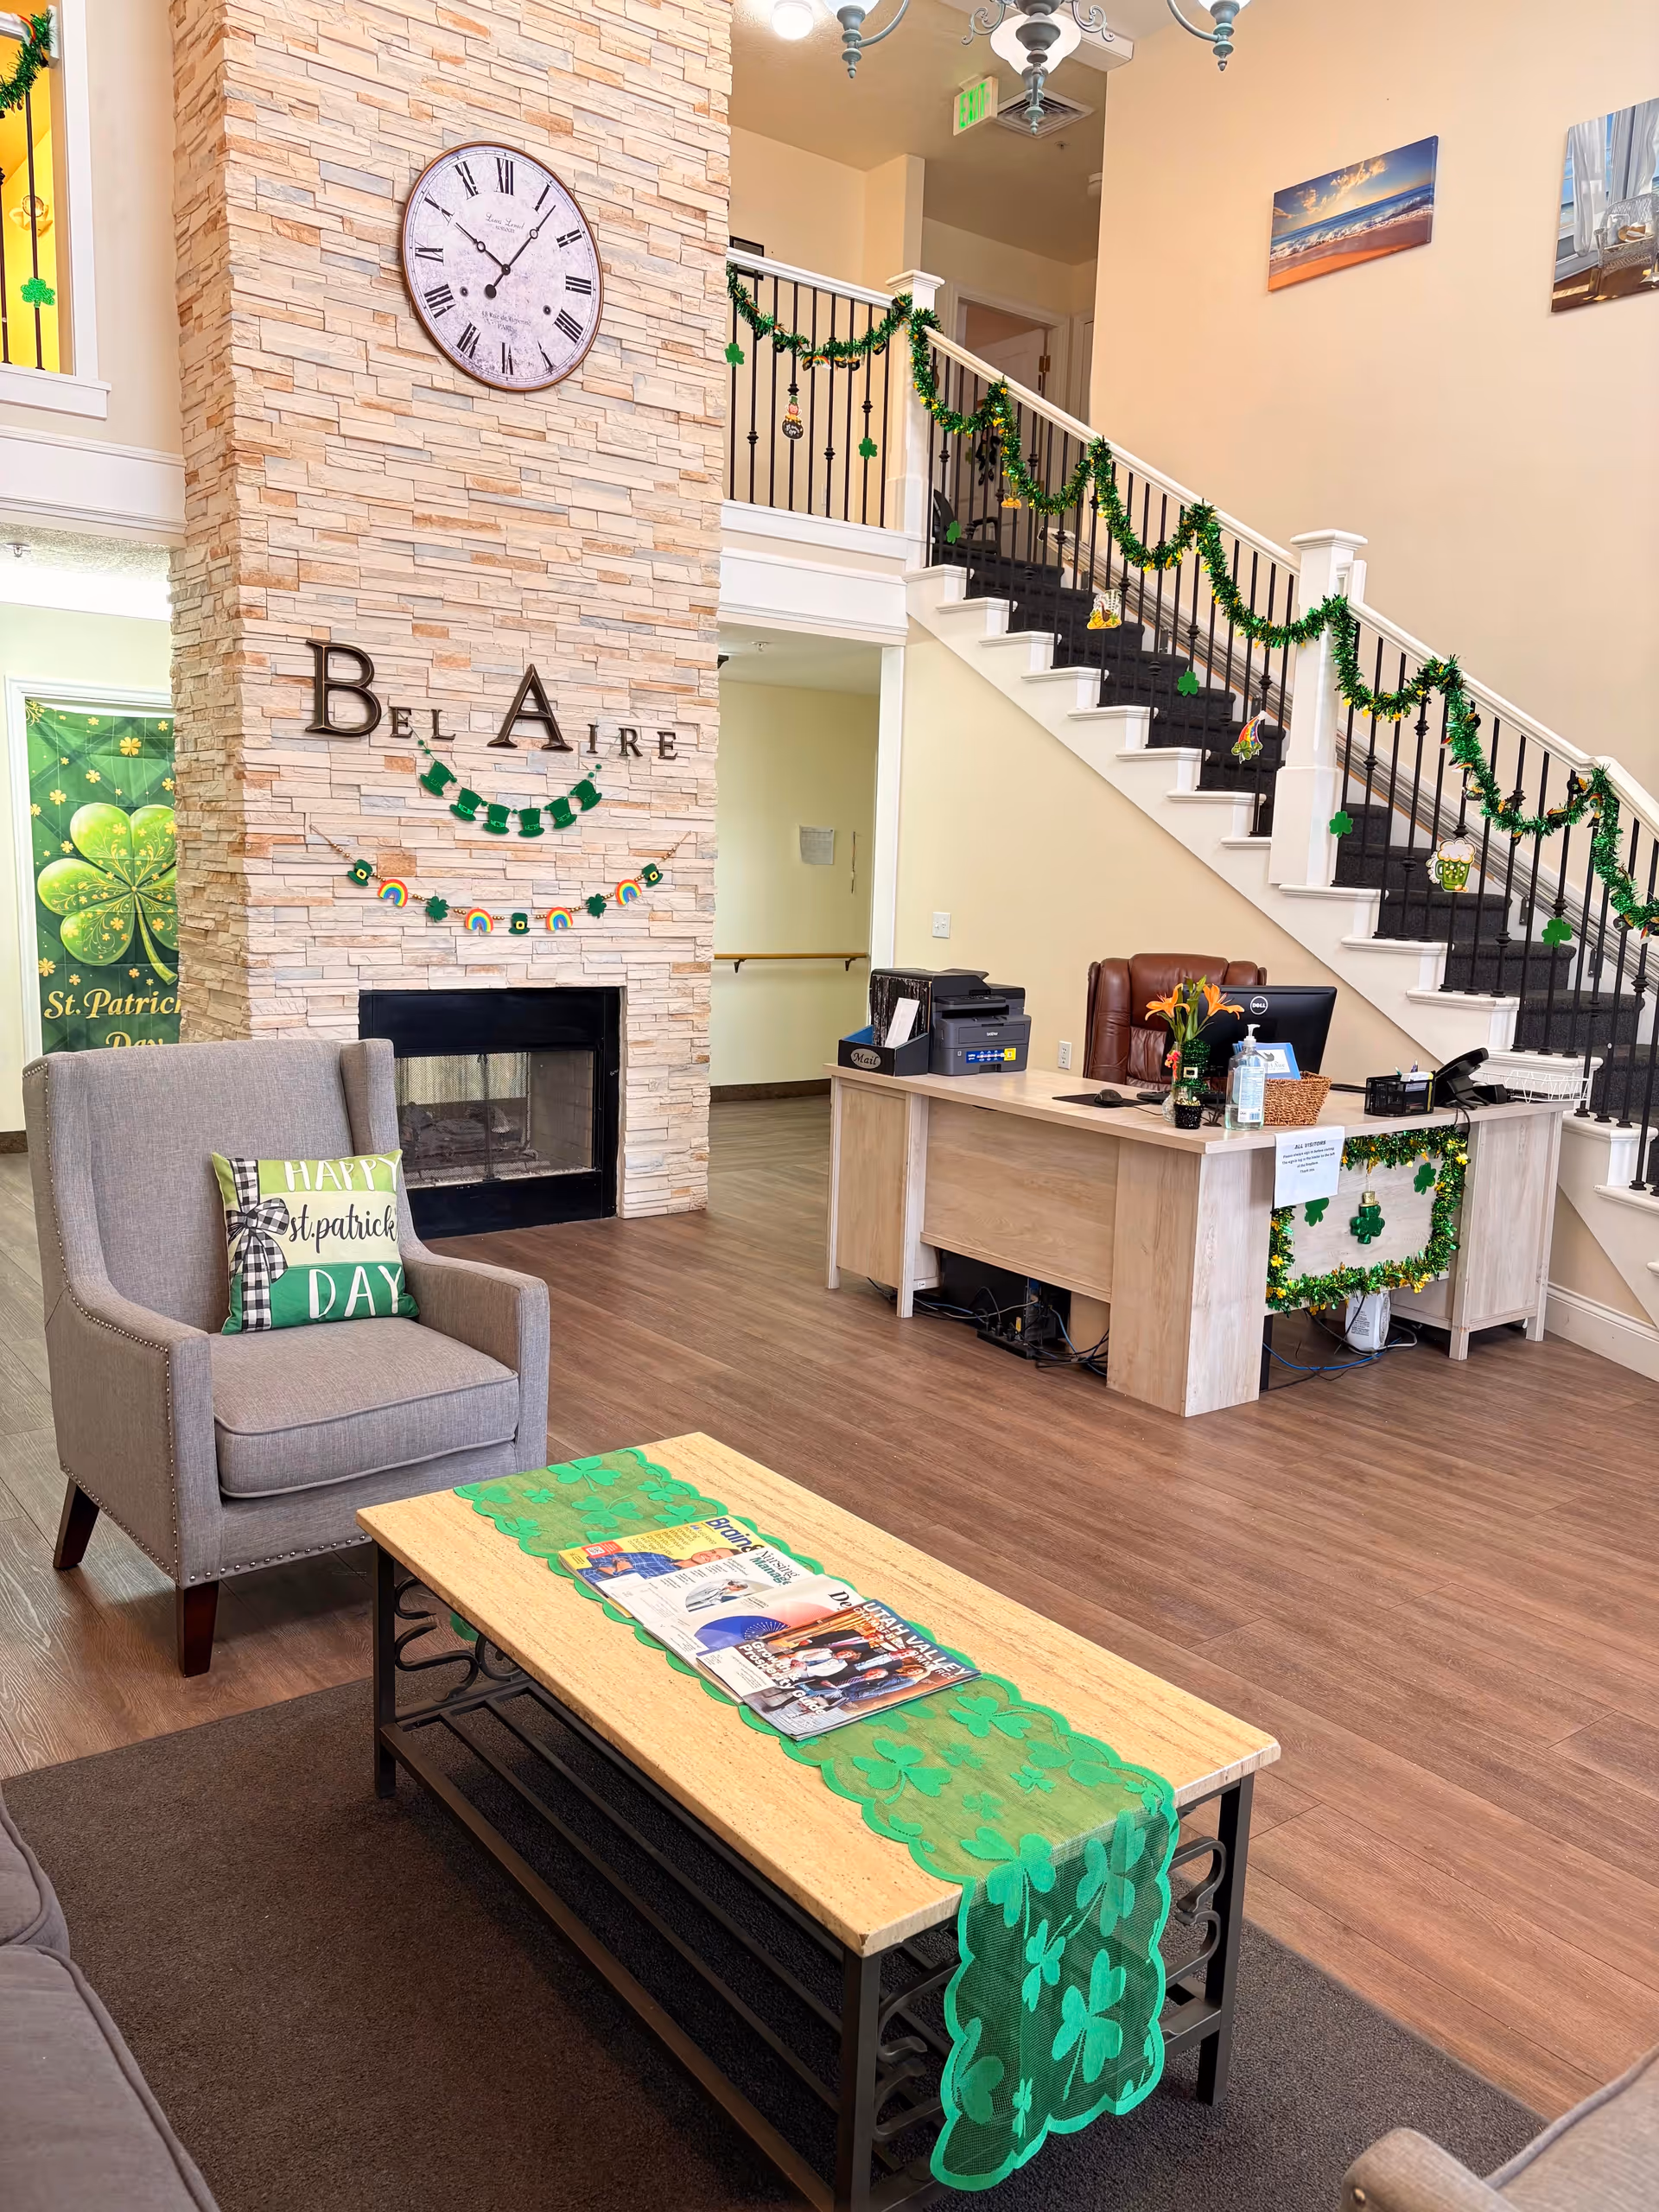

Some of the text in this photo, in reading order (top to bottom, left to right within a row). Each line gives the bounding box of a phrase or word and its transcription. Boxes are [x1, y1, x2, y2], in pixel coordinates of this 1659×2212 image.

[960, 82, 987, 129] EXIT
[494, 156, 515, 197] XII
[44, 991, 81, 1019] St.
[854, 1052, 879, 1065] Mail
[284, 1154, 402, 1192] HAPPY
[308, 1266, 402, 1319] DAY
[755, 1551, 800, 1579] Nursing
[752, 1642, 791, 1672] Growth
[862, 1602, 973, 1675] UTAH VALLEY
[739, 1644, 796, 1689] Prosperity
[792, 1690, 826, 1715] Guide
